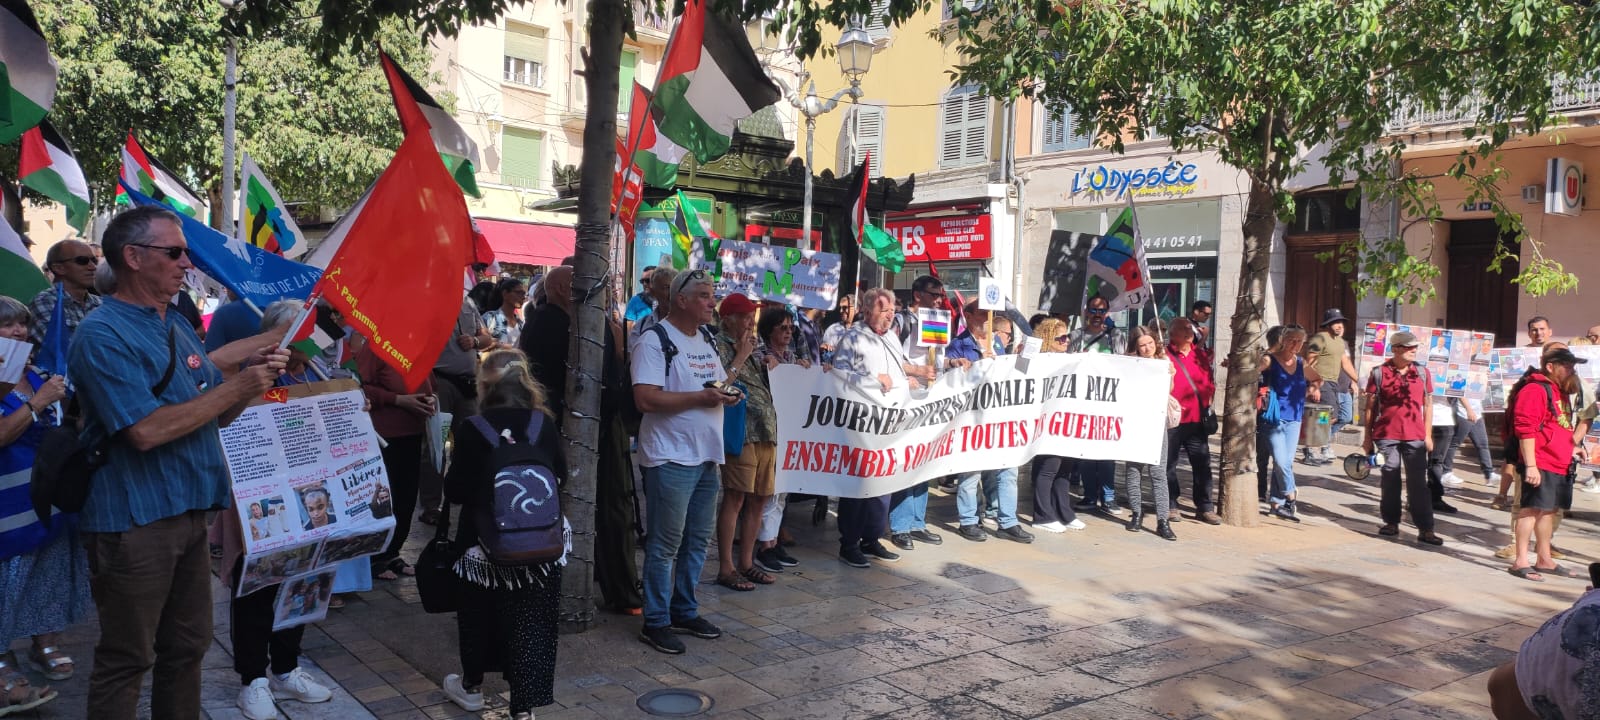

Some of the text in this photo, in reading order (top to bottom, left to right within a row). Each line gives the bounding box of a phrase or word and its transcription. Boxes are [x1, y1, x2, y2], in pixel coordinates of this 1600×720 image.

[936, 236, 955, 244] MAISON
[948, 243, 971, 251] TAMPONS
[1153, 237, 1167, 248] 41
[1170, 236, 1185, 248] 05
[1187, 235, 1202, 247] 41
[783, 247, 821, 272] Paix
[277, 278, 294, 293] DE
[293, 273, 310, 288] LA
[802, 395, 908, 436] JOURNÉE
[1041, 375, 1058, 403] DE
[1056, 373, 1077, 398] LA
[1085, 375, 1120, 402] PAIX
[782, 440, 897, 478] ENSEMBLE
[903, 429, 956, 473] CONTRE
[960, 420, 1028, 452] TOUTES
[1048, 412, 1123, 441] GUERRES
[341, 466, 382, 491] Libérez
